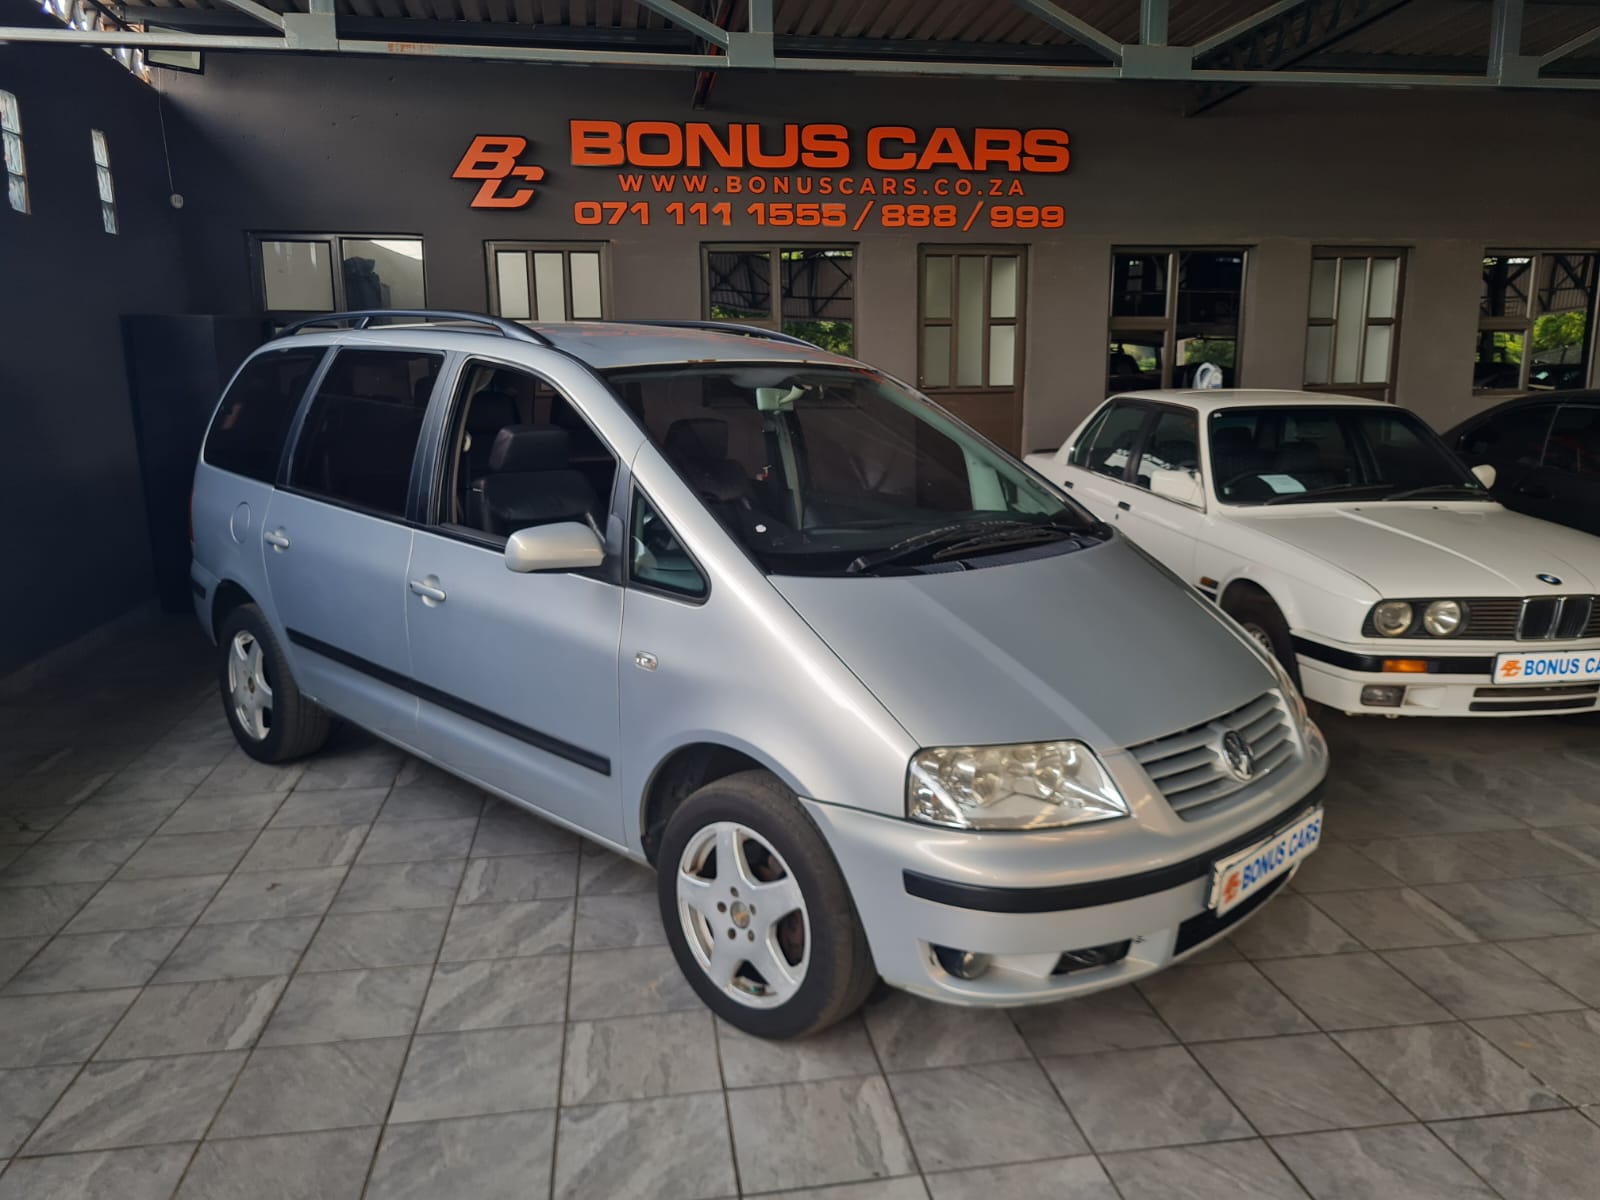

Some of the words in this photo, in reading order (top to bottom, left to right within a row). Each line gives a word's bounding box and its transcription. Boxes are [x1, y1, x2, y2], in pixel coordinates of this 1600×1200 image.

[570, 120, 850, 169] BONUS
[866, 126, 1070, 173] CARS
[618, 174, 1024, 197] WWW.BONUSCARS.CO.ZA
[574, 201, 649, 225] 071
[665, 202, 732, 226] 111
[1524, 658, 1580, 676] BONUS
[1242, 841, 1286, 890] BONUS
[1289, 818, 1321, 857] CARS
